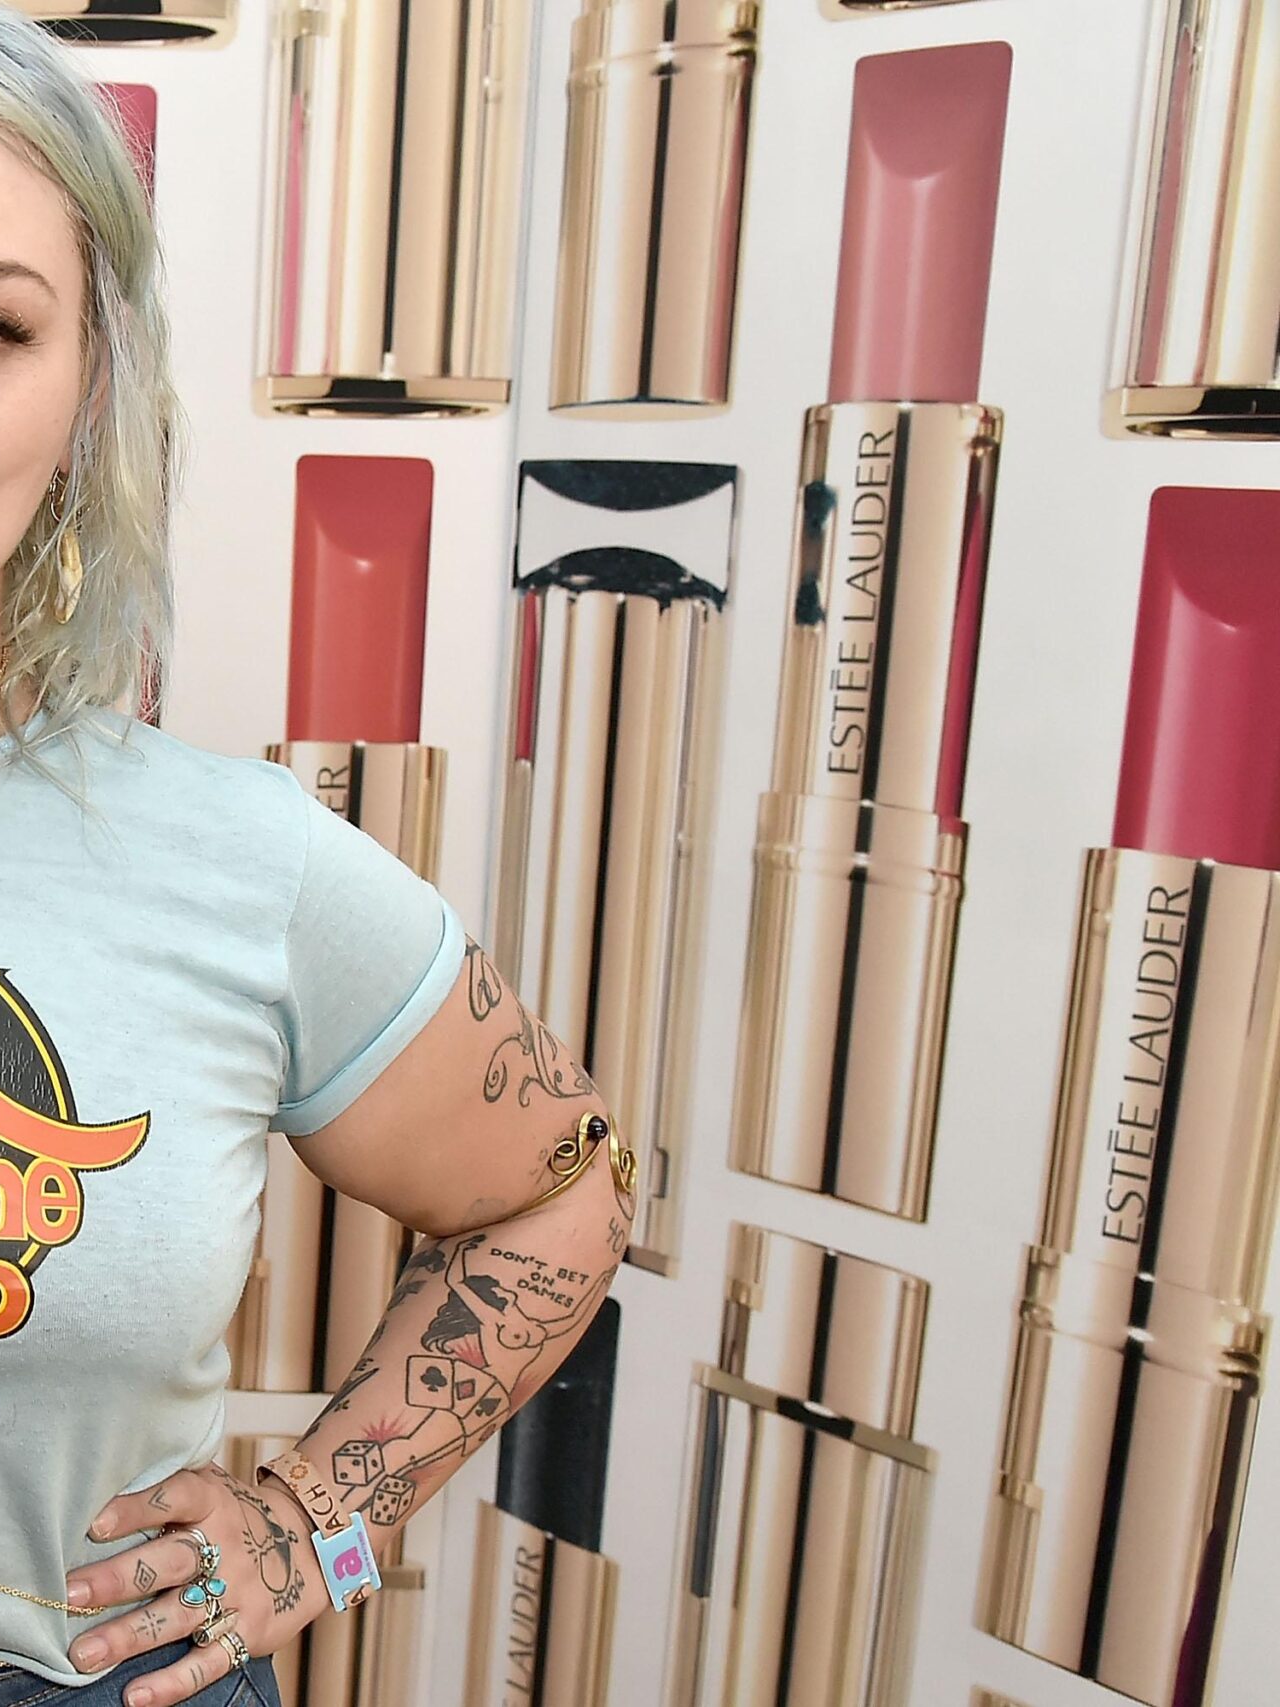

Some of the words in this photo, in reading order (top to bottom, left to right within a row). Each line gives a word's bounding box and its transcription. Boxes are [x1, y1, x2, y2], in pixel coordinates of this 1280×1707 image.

[843, 429, 895, 622] LAUDER
[1123, 885, 1190, 1087] LAUDER
[490, 1248, 548, 1270] DON'T
[557, 1267, 590, 1285] BET
[517, 1278, 574, 1308] DAMES
[530, 1271, 555, 1287] ON
[506, 1546, 542, 1695] LAUDER
